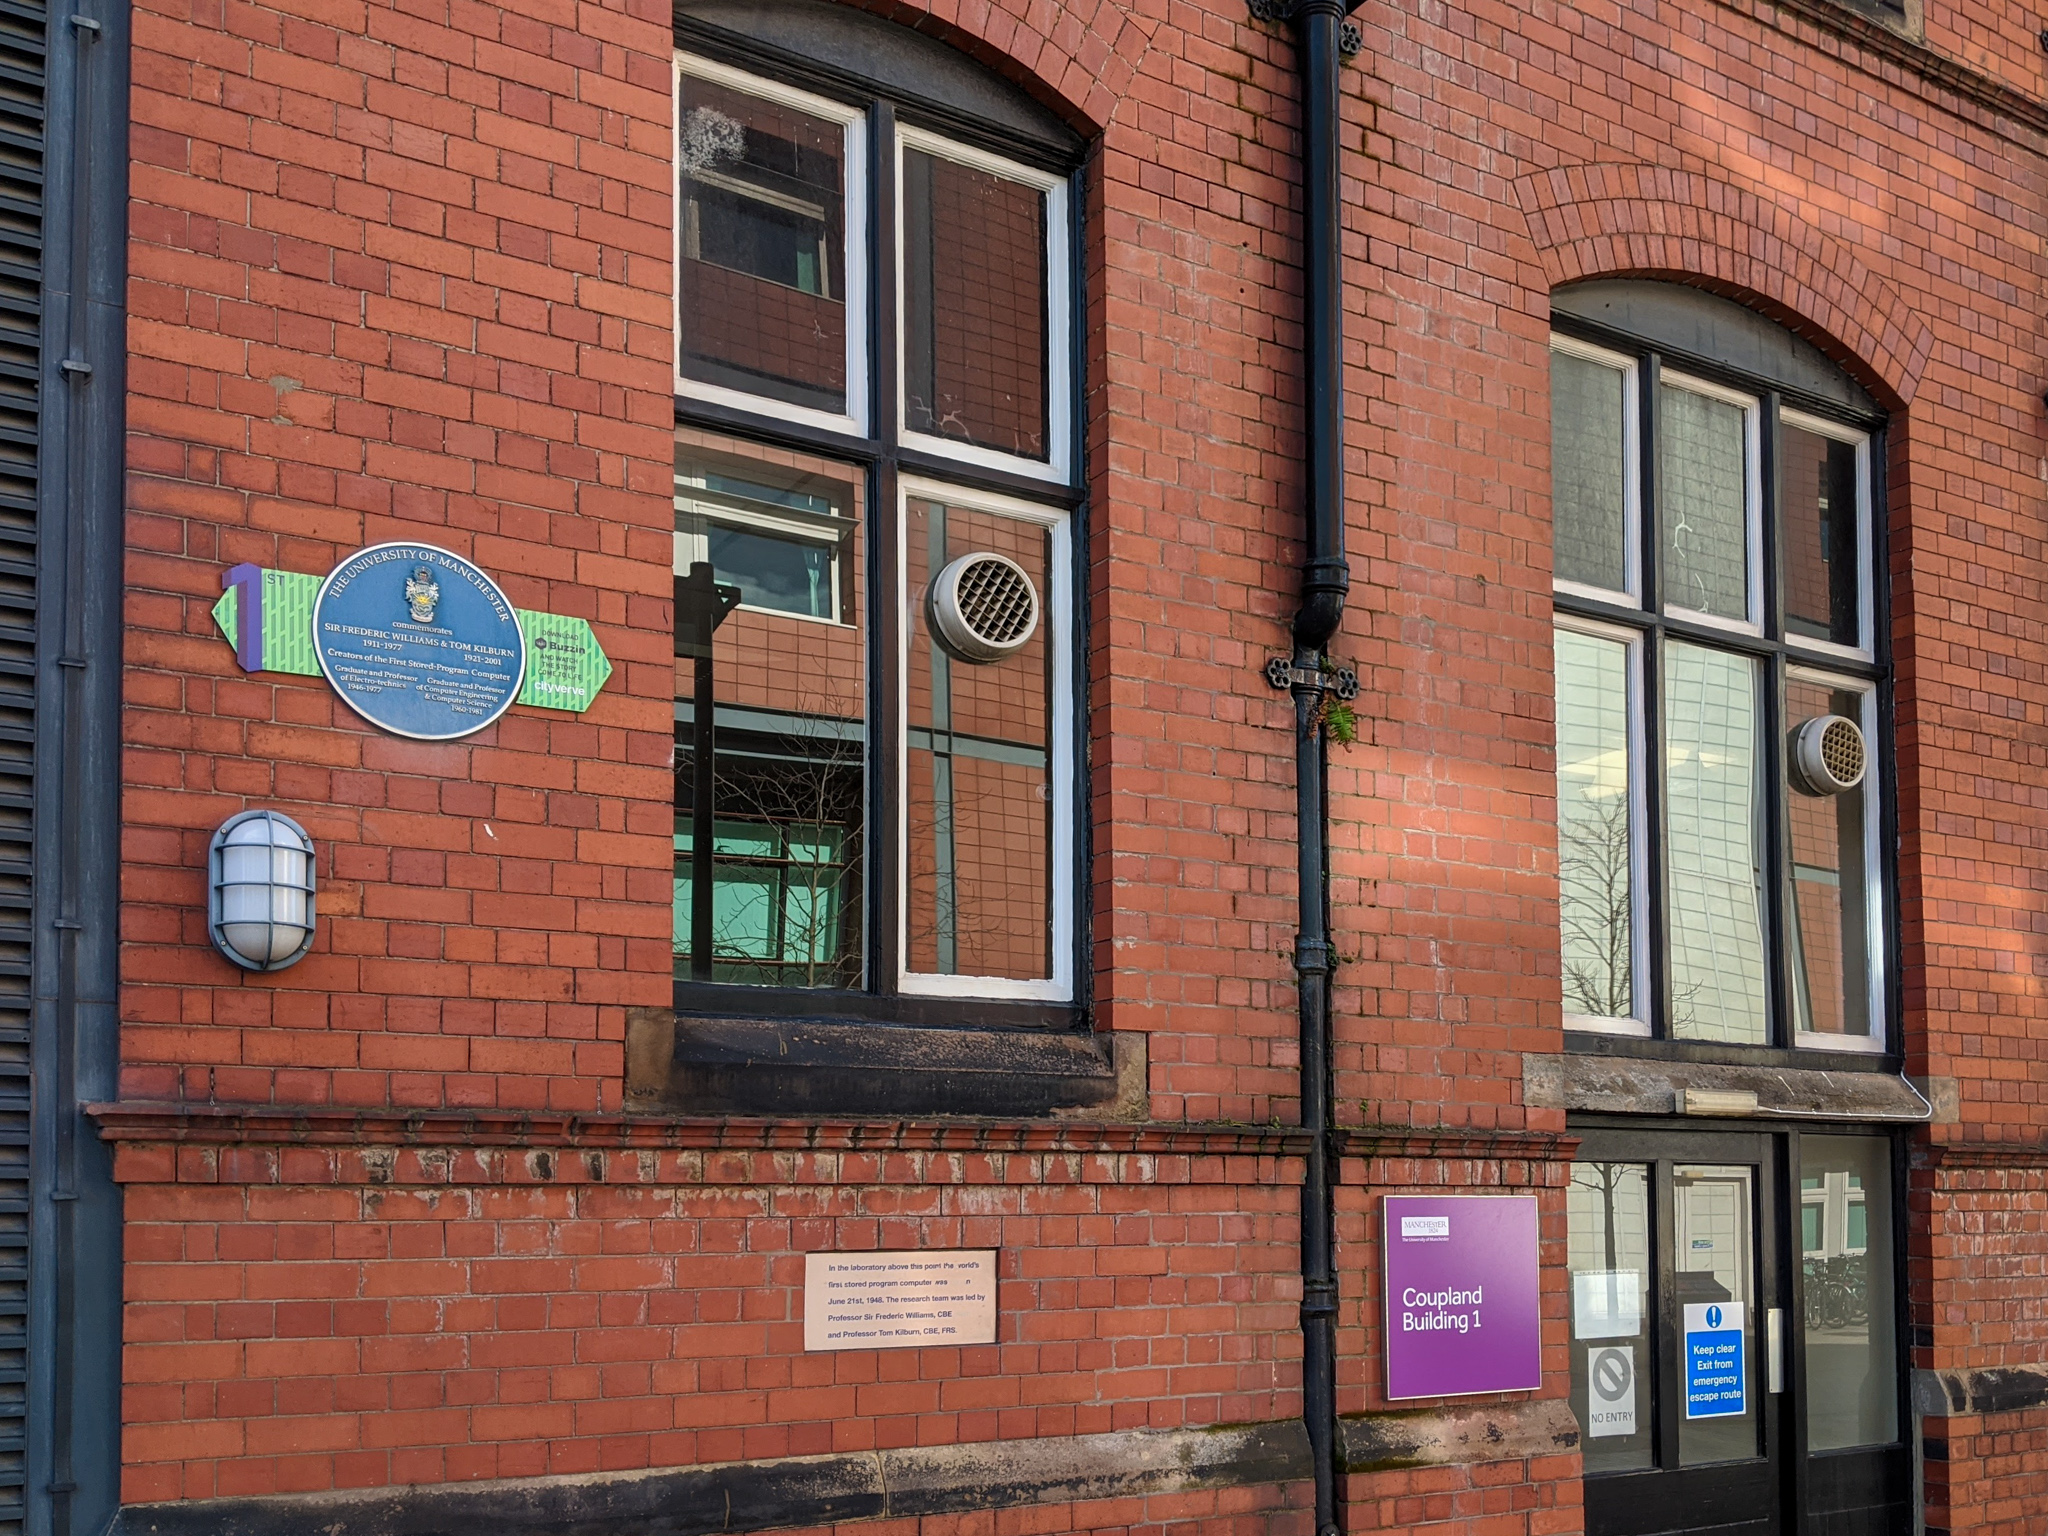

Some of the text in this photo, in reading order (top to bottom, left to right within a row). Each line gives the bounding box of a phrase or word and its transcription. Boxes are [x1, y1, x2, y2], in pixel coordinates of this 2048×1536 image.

[267, 573, 285, 586] ST
[329, 549, 510, 622] THE UNIVERSITY OF MANCHESTER
[392, 621, 453, 636] commemorates
[542, 629, 579, 640] DOWNLOAD
[324, 622, 515, 658] SIR FREDERIC WILLIAMS & TOM KILBURN
[363, 639, 403, 651] 1911-1977
[550, 642, 586, 654] Buzzin
[327, 648, 511, 681] Creators of the First Stored-Program Computer
[464, 654, 502, 666] 1921-2001
[556, 655, 578, 664] WATCH
[335, 664, 418, 682] Graduate and Professor
[538, 669, 557, 677] COME
[556, 664, 576, 672] STORY
[348, 683, 382, 693] 1946-1977
[427, 677, 506, 694] Graduate and Professor
[534, 680, 585, 696] cityverve
[424, 685, 458, 695] Computer
[459, 690, 499, 703] Engineering
[431, 694, 465, 705] Computer
[467, 699, 493, 709] Science
[850, 1264, 886, 1272] laboratory
[910, 1262, 923, 1270] this
[868, 1280, 898, 1288] program
[1403, 1285, 1483, 1310] Coupland
[1403, 1309, 1481, 1333] Building 1
[1693, 1344, 1736, 1356] Keep clear
[1697, 1359, 1733, 1370] Exit from
[1693, 1376, 1737, 1387] emergency
[1690, 1389, 1741, 1402] escape route
[1591, 1411, 1633, 1424] NO ENTRY
